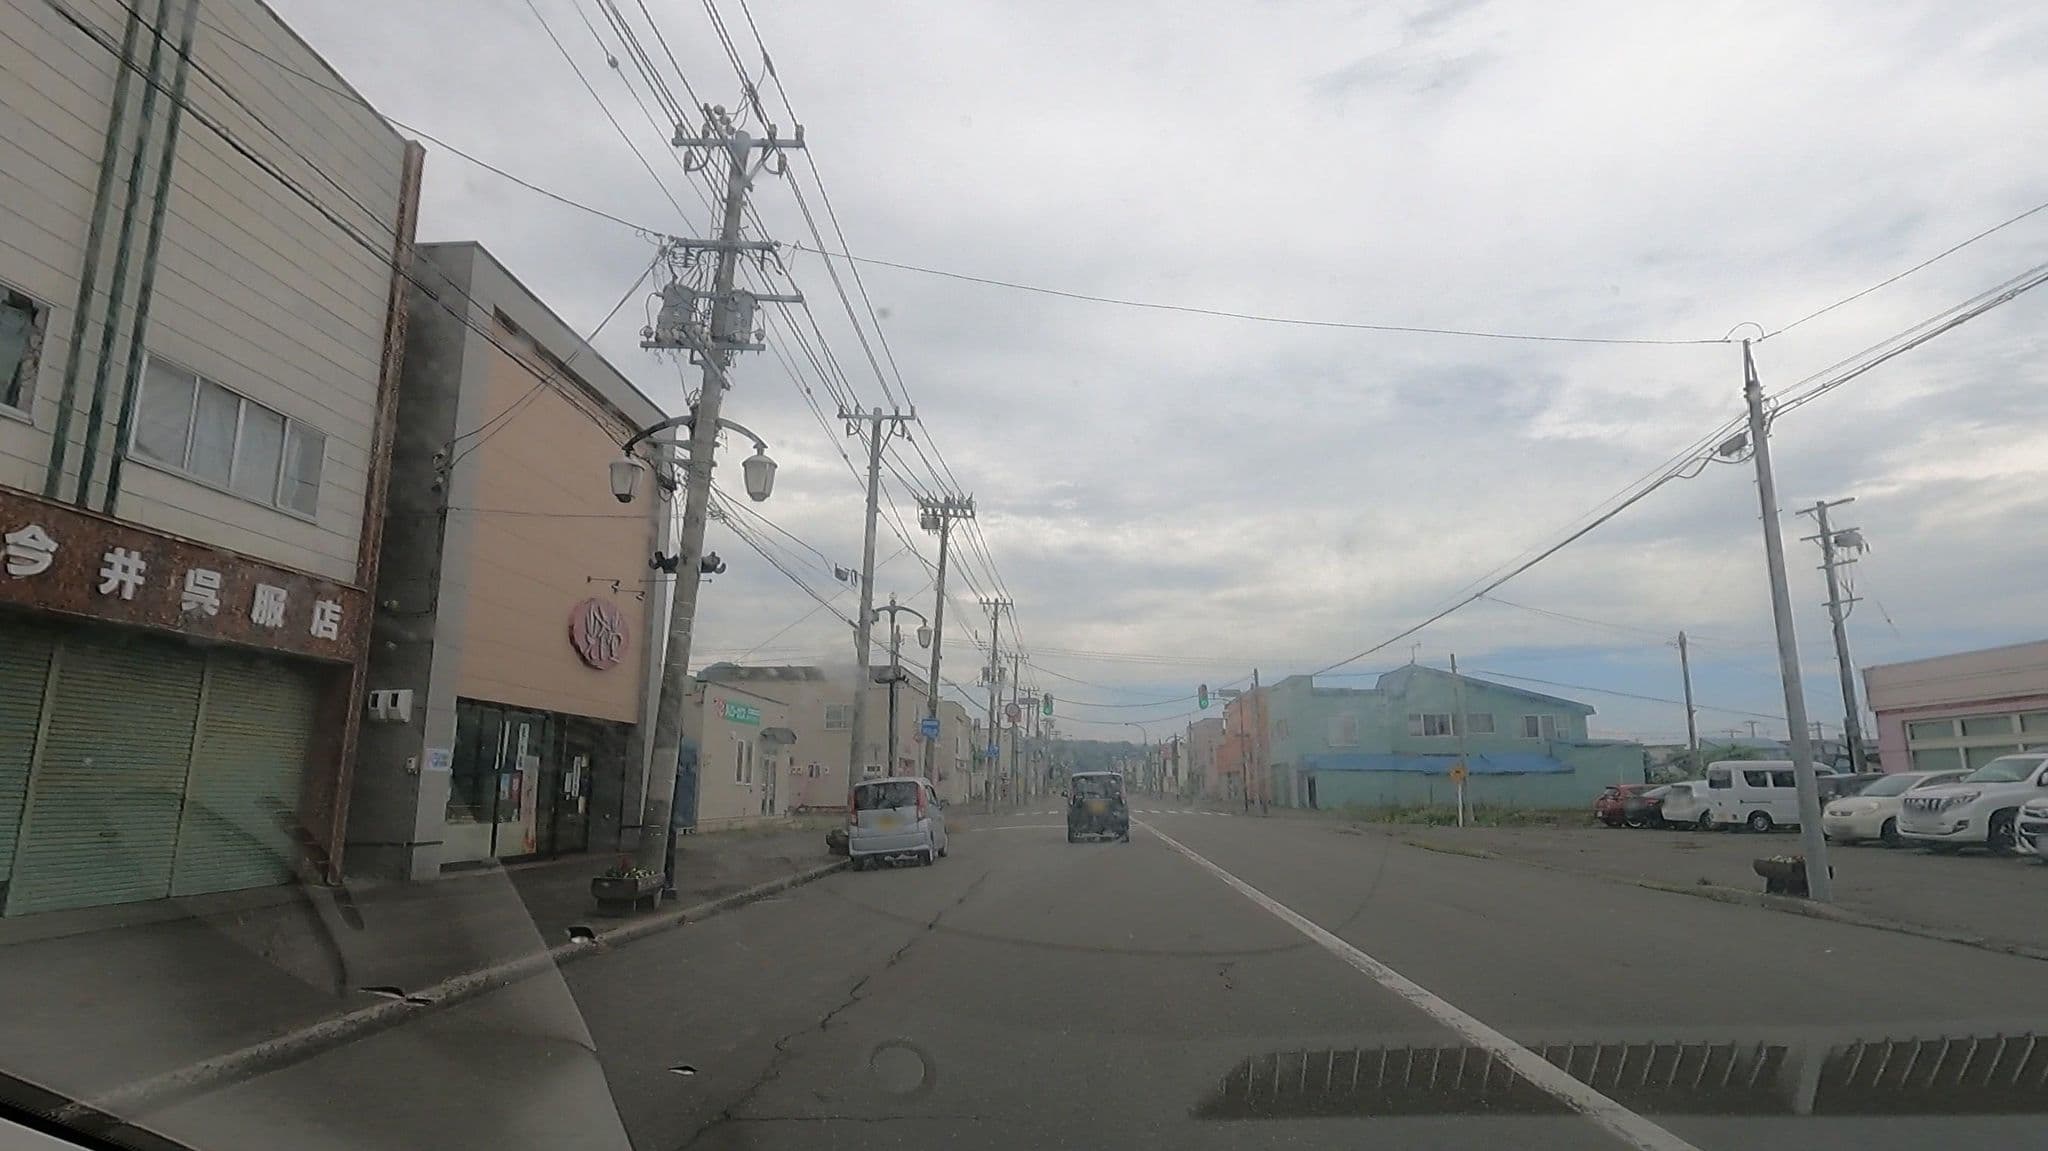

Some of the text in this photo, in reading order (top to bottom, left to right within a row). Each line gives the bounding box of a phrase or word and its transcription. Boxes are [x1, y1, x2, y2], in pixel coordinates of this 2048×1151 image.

[4, 524, 345, 641] 今井呉服店
